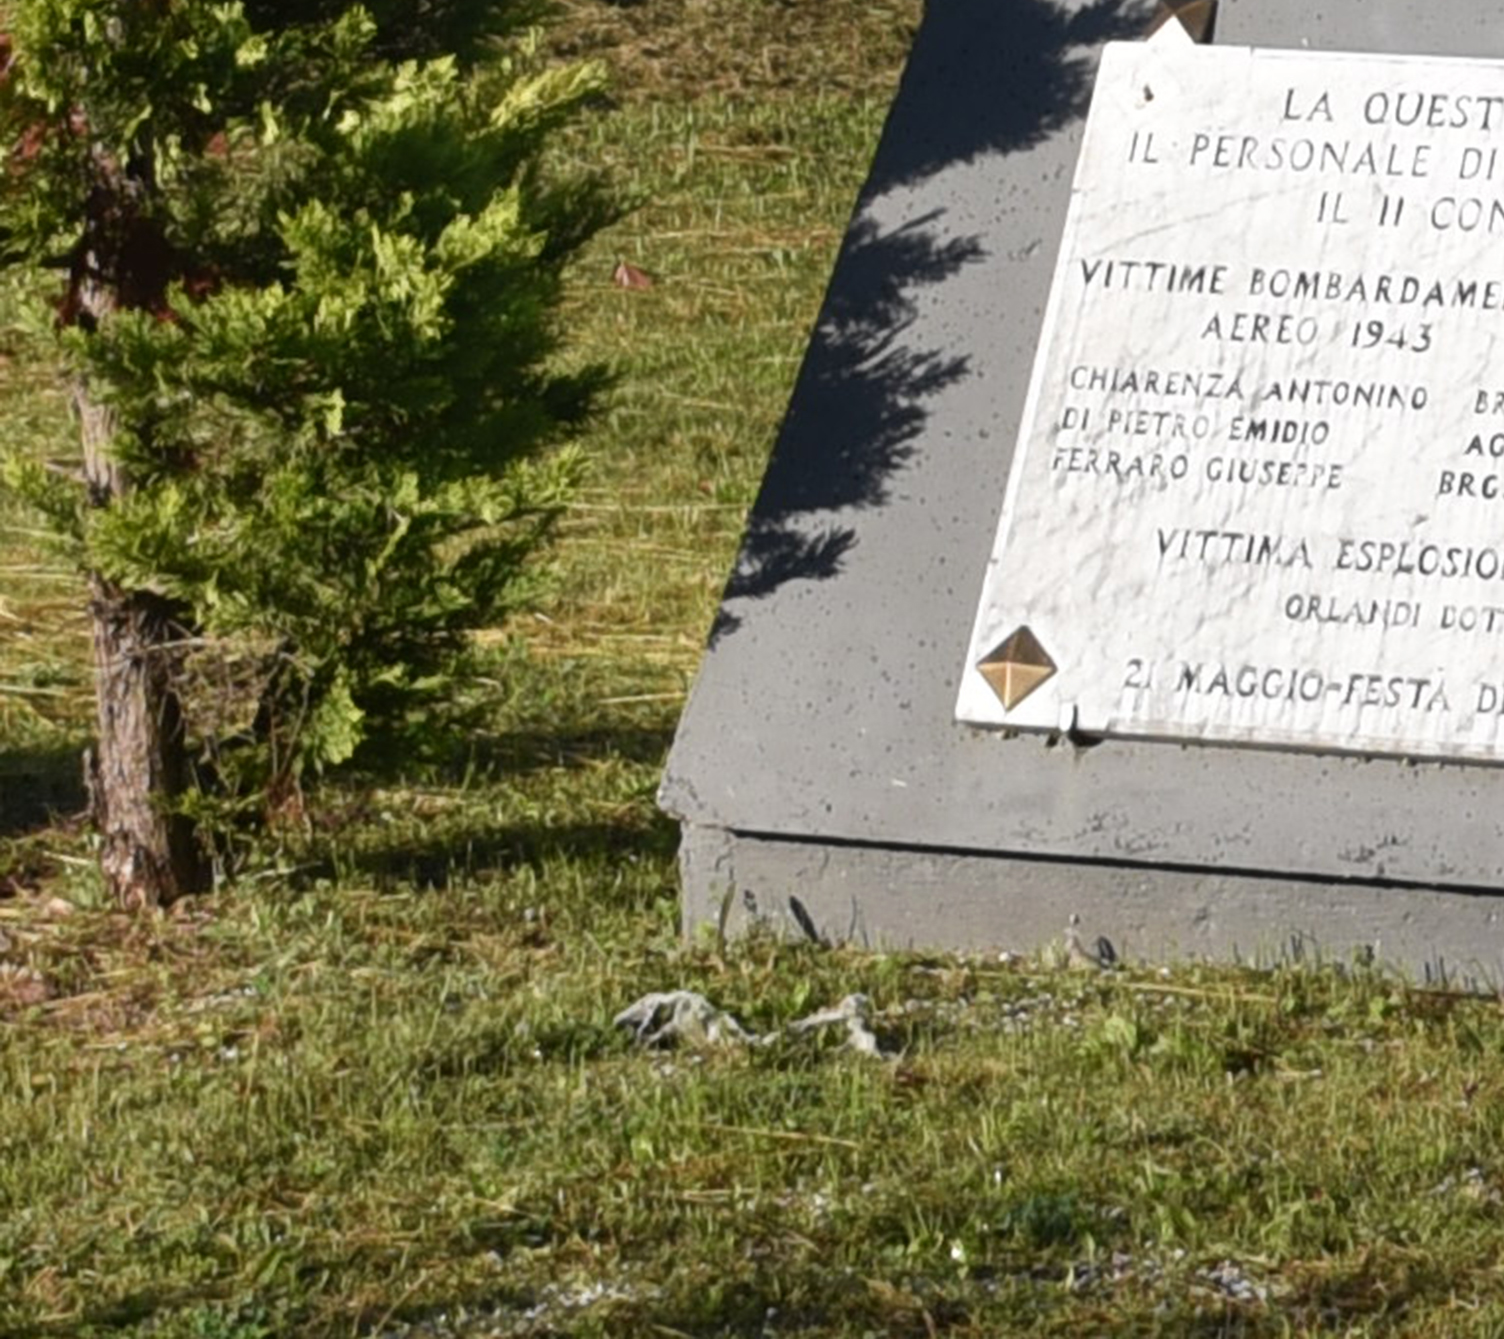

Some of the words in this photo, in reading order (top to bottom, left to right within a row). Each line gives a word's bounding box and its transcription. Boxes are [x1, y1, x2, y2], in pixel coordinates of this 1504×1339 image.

[1283, 87, 1335, 123] LA
[1128, 131, 1159, 165] IL
[1189, 132, 1432, 180] PERSONALE
[1458, 147, 1498, 182] DI
[1316, 191, 1350, 225] IL
[1079, 258, 1230, 296] VITTIME
[1200, 312, 1320, 349] AEREO
[1349, 319, 1434, 354] 1943
[1069, 365, 1246, 402] CHIARENZA
[1259, 376, 1430, 414] ANTONINO
[1060, 405, 1089, 432] DI
[1105, 408, 1211, 441] PIETRO
[1228, 415, 1331, 448] EMIDIO
[1051, 445, 1190, 482] FERRARO
[1205, 456, 1345, 491] GIUSEPPE
[1155, 526, 1314, 570] VITTIMA
[1284, 592, 1421, 630] ORLANDI
